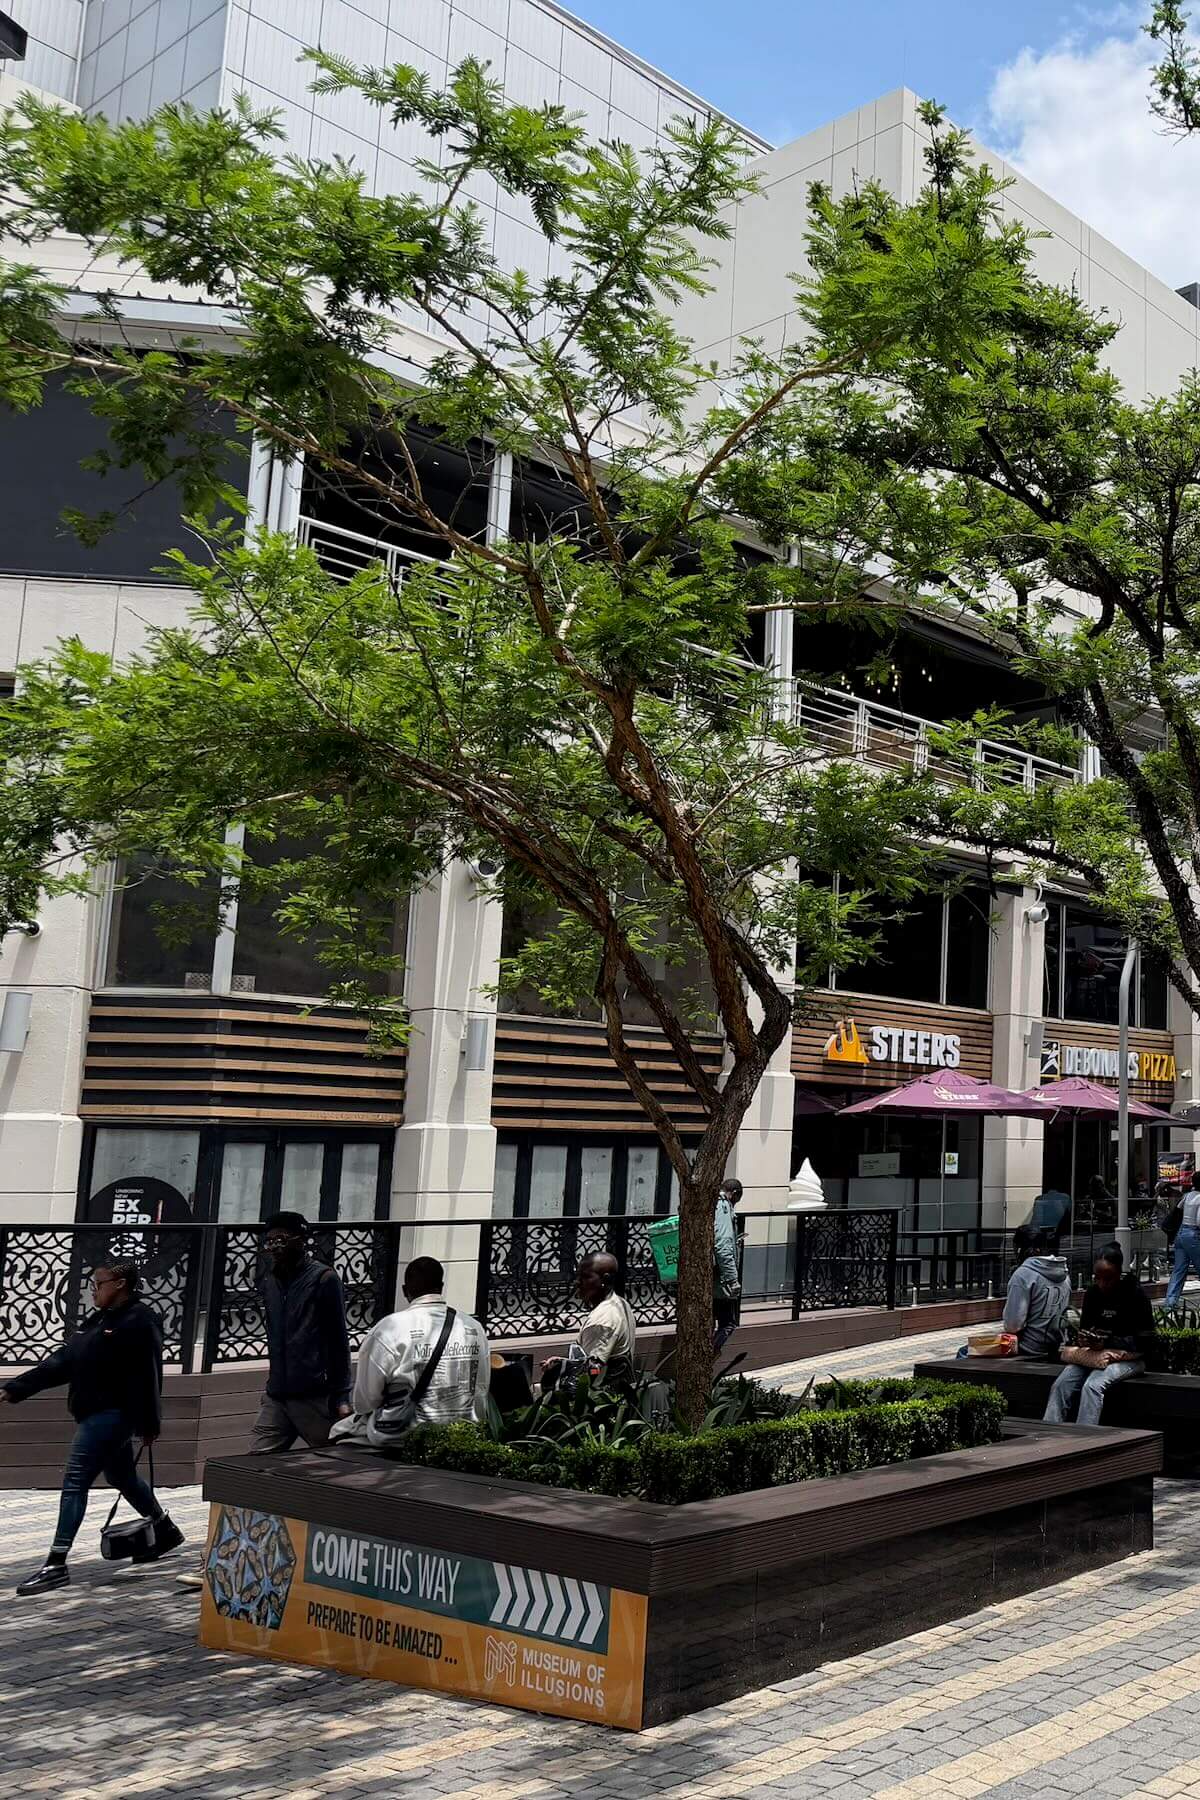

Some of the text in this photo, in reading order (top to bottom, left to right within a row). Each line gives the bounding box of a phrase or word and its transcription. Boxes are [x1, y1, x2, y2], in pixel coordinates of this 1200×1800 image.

[869, 1026, 961, 1068] STEERS
[1143, 1053, 1177, 1081] PIZZA
[112, 1214, 151, 1225] PER
[113, 1199, 140, 1212] EX
[312, 1531, 461, 1605] COME THIS WAY
[307, 1601, 357, 1637] PREPARE
[359, 1614, 373, 1642] TO
[376, 1619, 391, 1646] BE
[392, 1624, 443, 1660] AMAZED
[522, 1648, 606, 1684] MUSEUM OF
[521, 1669, 605, 1708] ILLUSIONS
